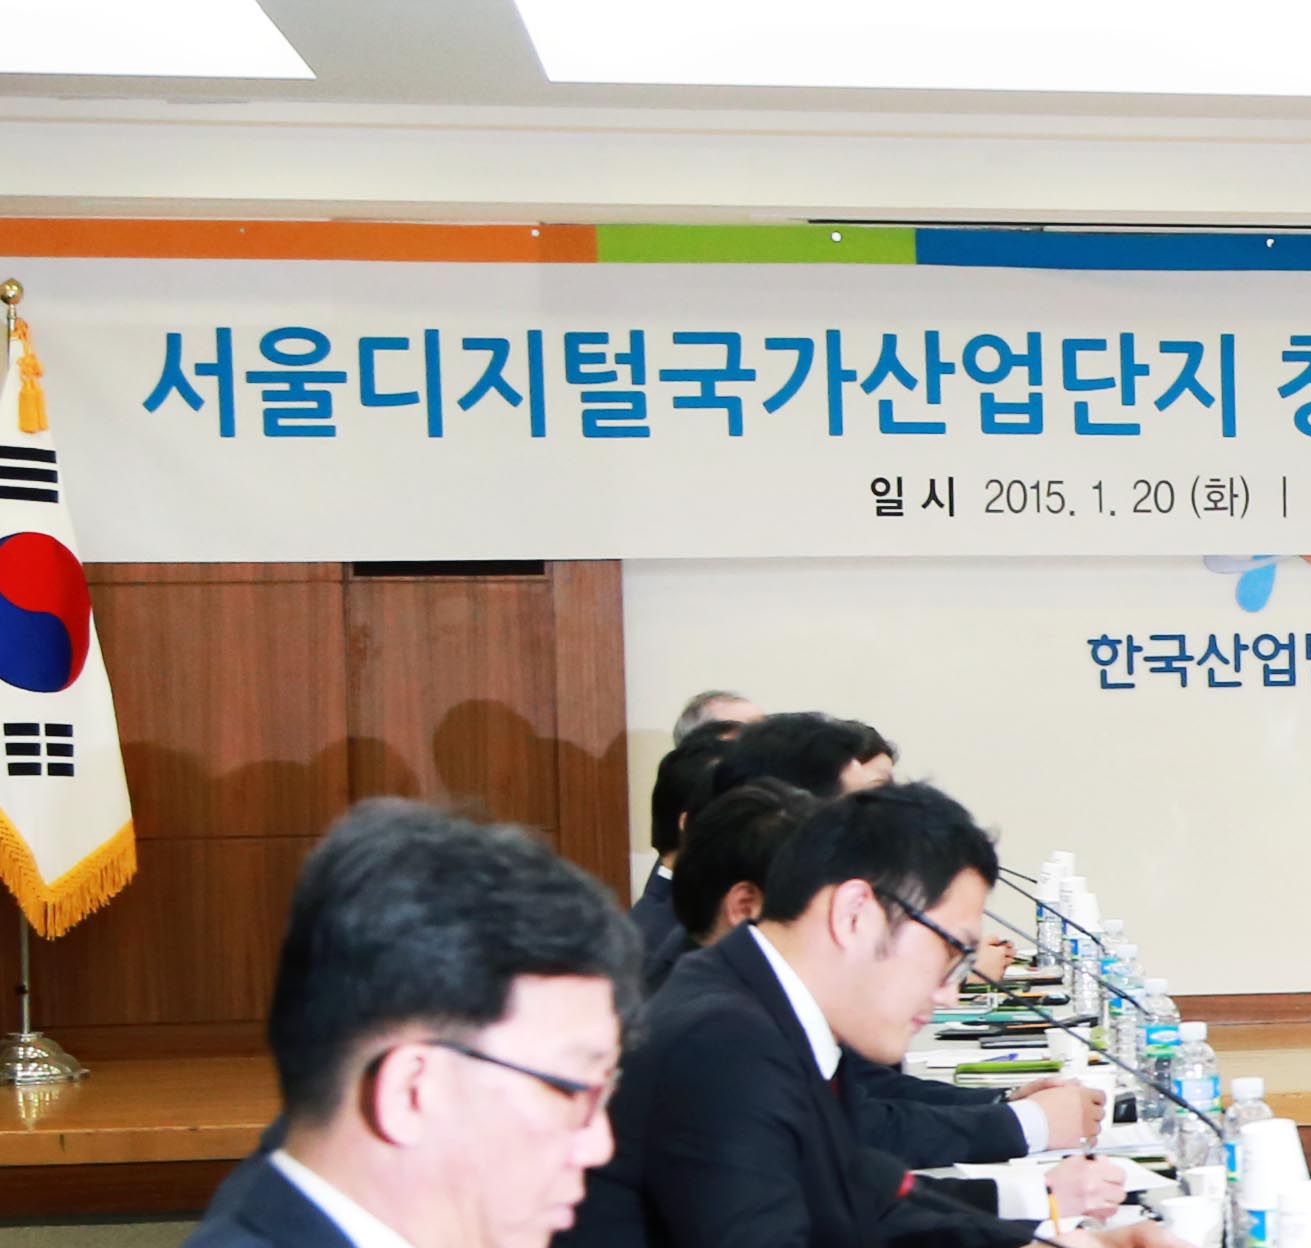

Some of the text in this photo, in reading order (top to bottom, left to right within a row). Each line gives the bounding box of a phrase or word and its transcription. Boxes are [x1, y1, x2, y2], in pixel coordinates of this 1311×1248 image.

[143, 327, 1236, 438] 서울디지털국가산업단지
[984, 479, 1075, 516] 2015.
[1092, 480, 1116, 516] 1.
[1133, 479, 1175, 514] 20
[1190, 475, 1251, 519] (화)
